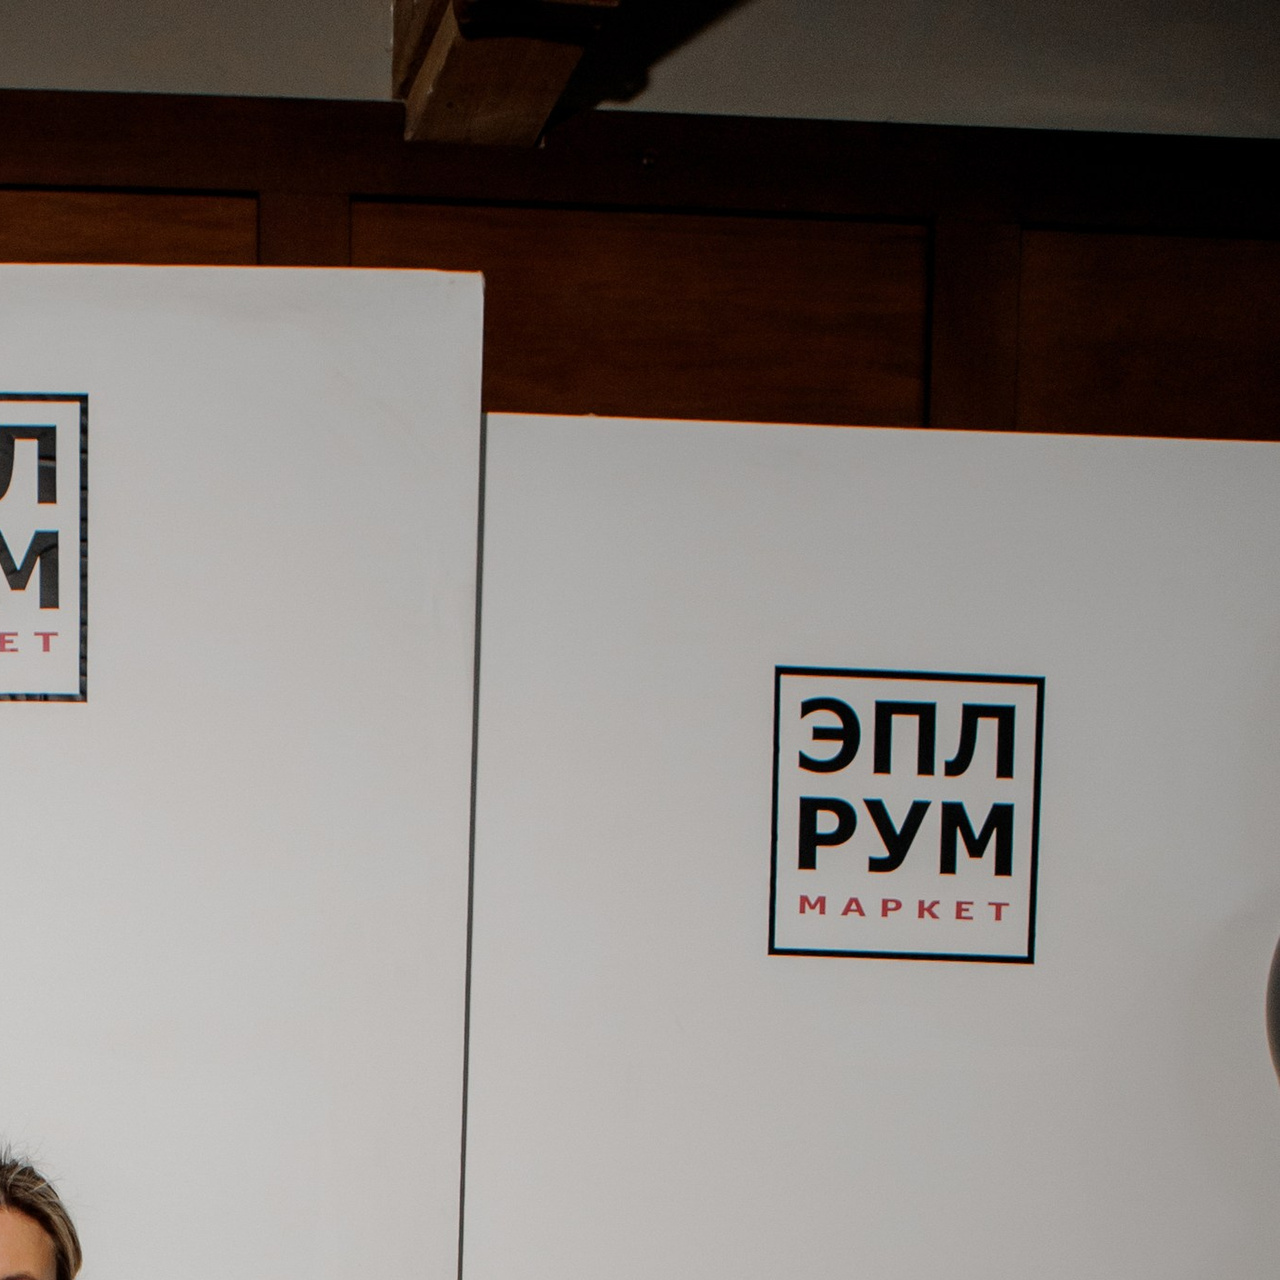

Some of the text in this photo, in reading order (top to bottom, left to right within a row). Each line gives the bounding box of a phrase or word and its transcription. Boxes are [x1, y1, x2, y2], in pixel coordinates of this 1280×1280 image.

[798, 696, 1016, 779] ЭПЛ
[798, 796, 1014, 876] РУМ
[798, 895, 1010, 921] МАРКЕТ
